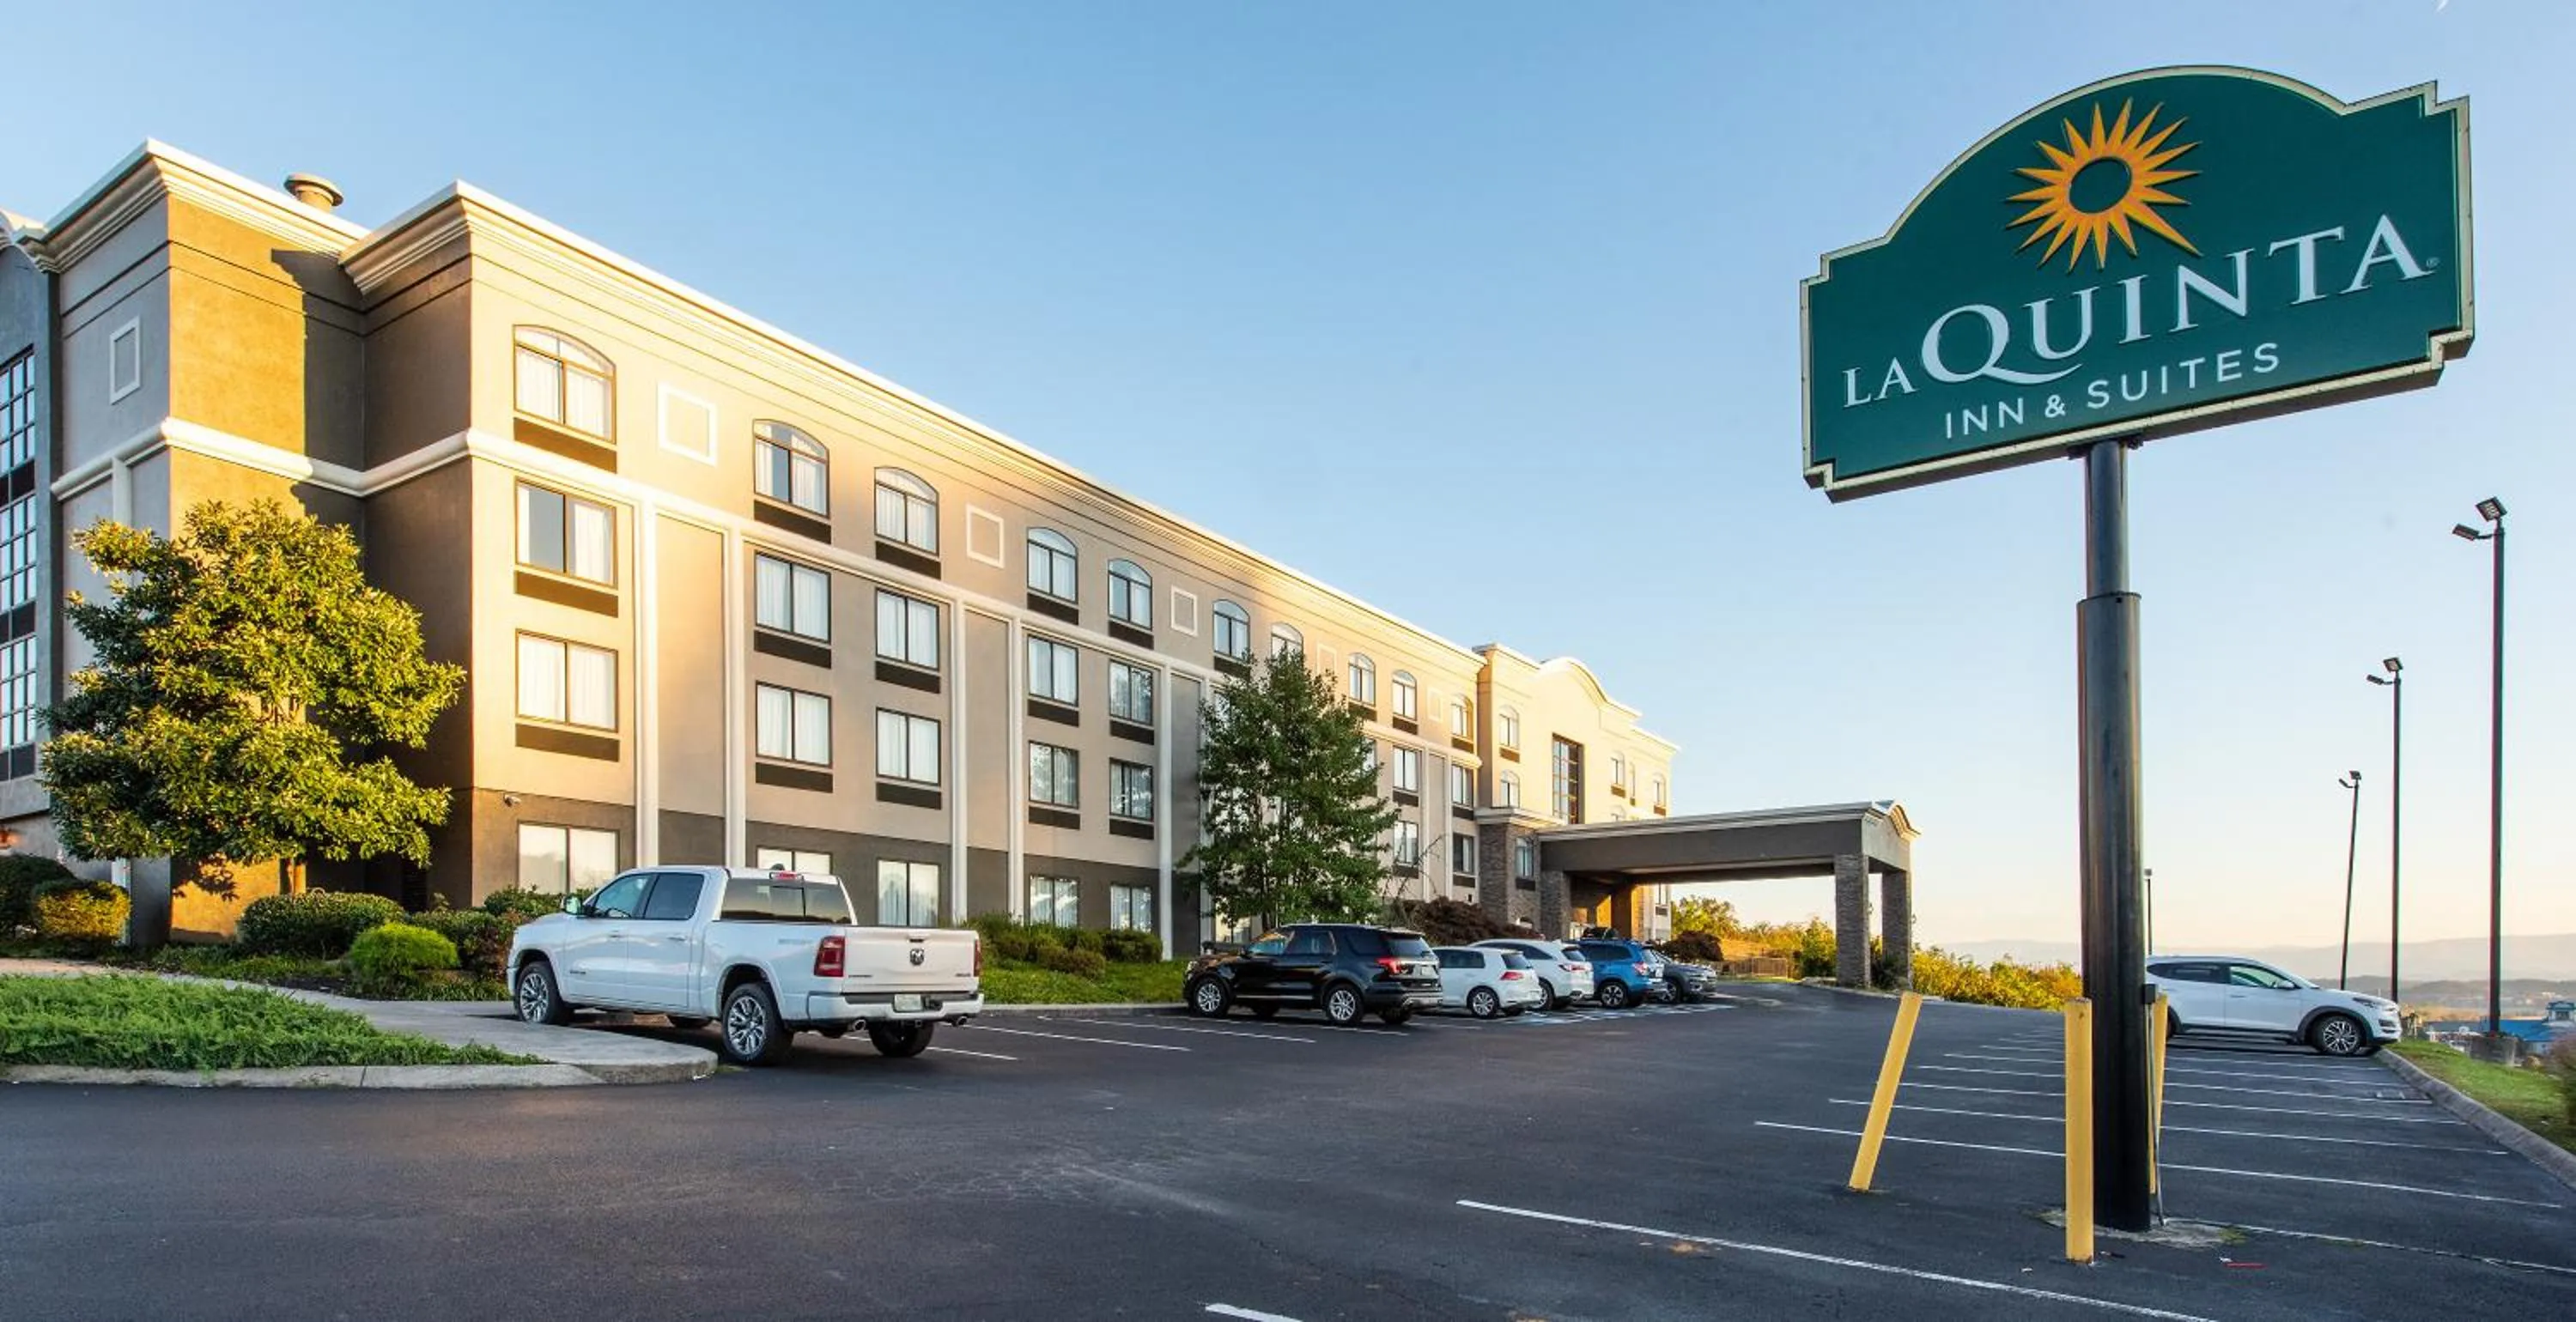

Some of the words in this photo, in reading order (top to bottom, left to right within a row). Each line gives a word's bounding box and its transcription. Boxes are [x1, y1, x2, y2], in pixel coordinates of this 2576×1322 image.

[1844, 358, 1920, 407] LA
[1921, 214, 2437, 385] QUINTA
[1946, 397, 2024, 439] INN
[2044, 394, 2067, 419] &
[2087, 343, 2279, 408] SUITES
